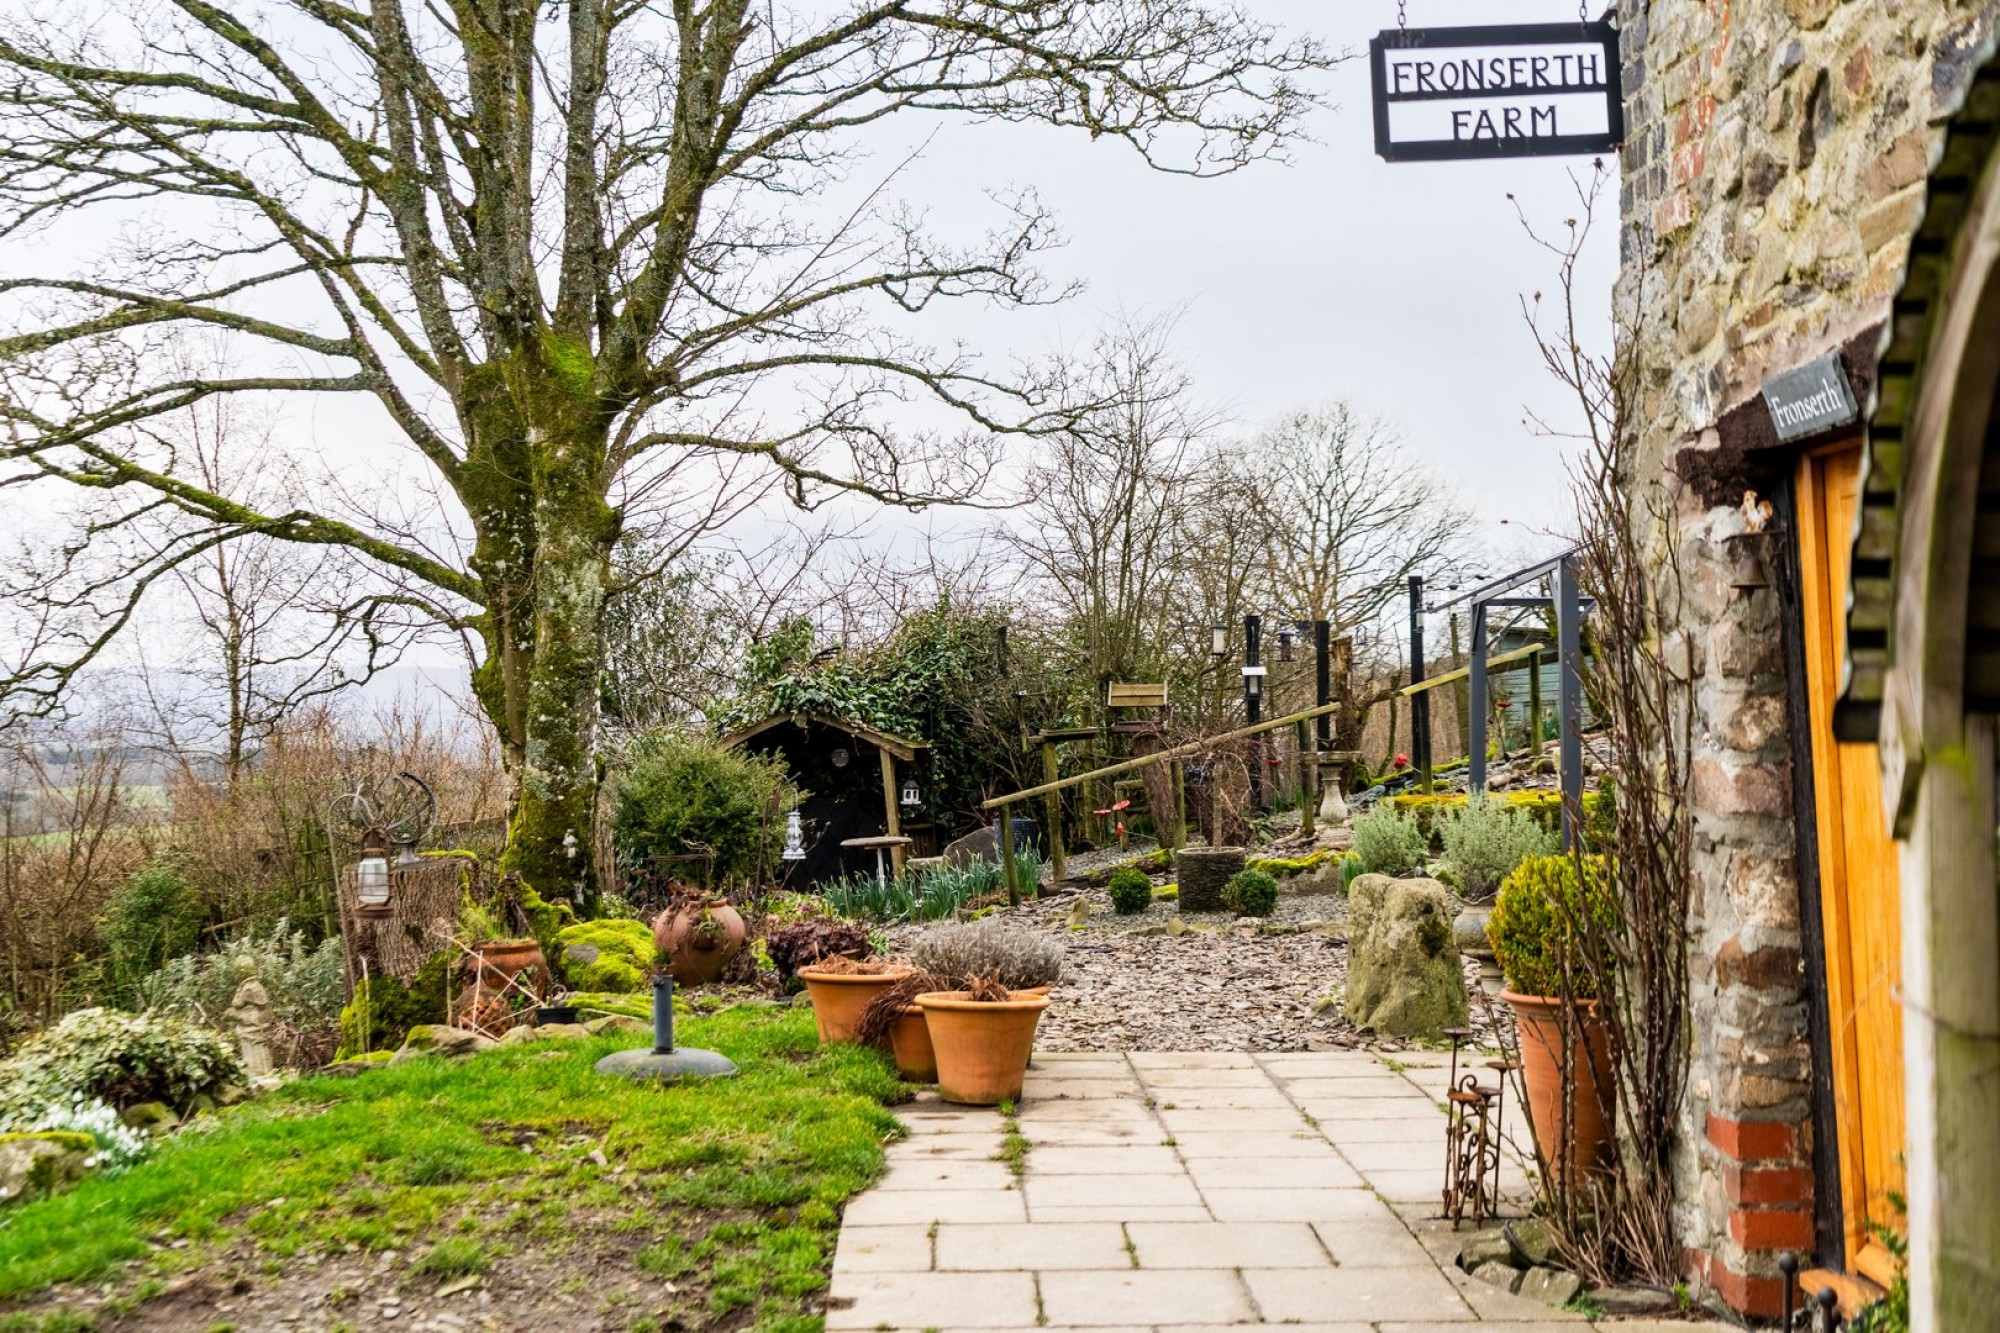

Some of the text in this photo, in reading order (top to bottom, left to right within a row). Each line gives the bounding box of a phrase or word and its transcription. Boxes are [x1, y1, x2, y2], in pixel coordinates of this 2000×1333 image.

[1392, 53, 1605, 94] FRONSERTH
[1451, 105, 1558, 139] FARM
[1770, 377, 1842, 428] Fronserth
